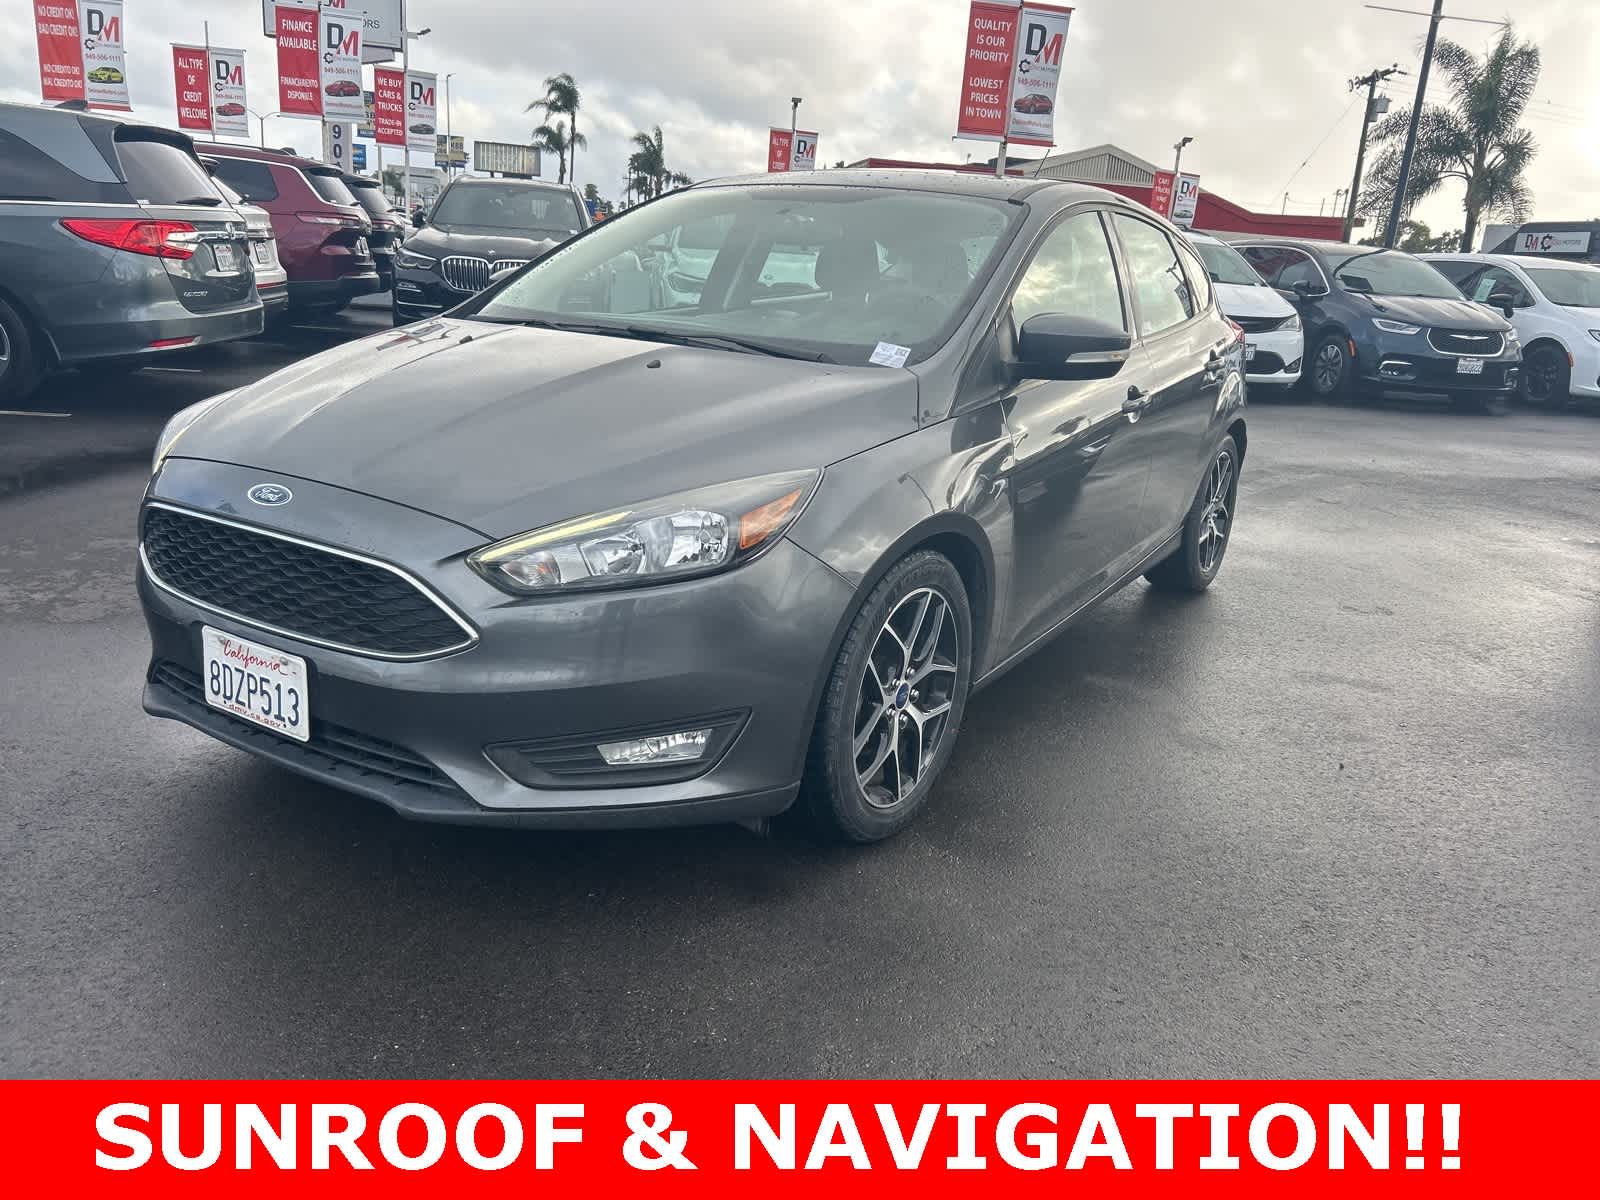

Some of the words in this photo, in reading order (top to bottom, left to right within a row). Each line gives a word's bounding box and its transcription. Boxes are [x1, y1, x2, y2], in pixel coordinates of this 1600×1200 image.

[46, 6, 64, 18] CREDIT
[39, 23, 50, 34] BAD
[50, 24, 67, 36] CREDIT
[282, 19, 313, 33] FINANCE
[974, 18, 1012, 32] QUALITY
[279, 36, 317, 51] AVAILABLE
[976, 35, 984, 45] IS
[986, 35, 1006, 48] OUR
[970, 49, 1009, 63] PRIORITY
[178, 57, 189, 69] ALL
[189, 58, 204, 70] TYPE
[187, 75, 196, 86] OF
[377, 77, 388, 87] WE
[388, 78, 402, 88] BUY
[969, 77, 1003, 89] LOWEST
[183, 90, 202, 103] CREDIT
[378, 90, 395, 99] CARS
[396, 92, 402, 100] &
[970, 91, 999, 104] PRICES
[180, 107, 208, 120] WELCOME
[377, 101, 403, 113] TRUCKS
[965, 107, 975, 117] IN
[975, 107, 1002, 119] TOWN
[377, 128, 403, 137] ACCEPTED
[224, 640, 288, 676] California
[210, 660, 299, 727] 8DZP513
